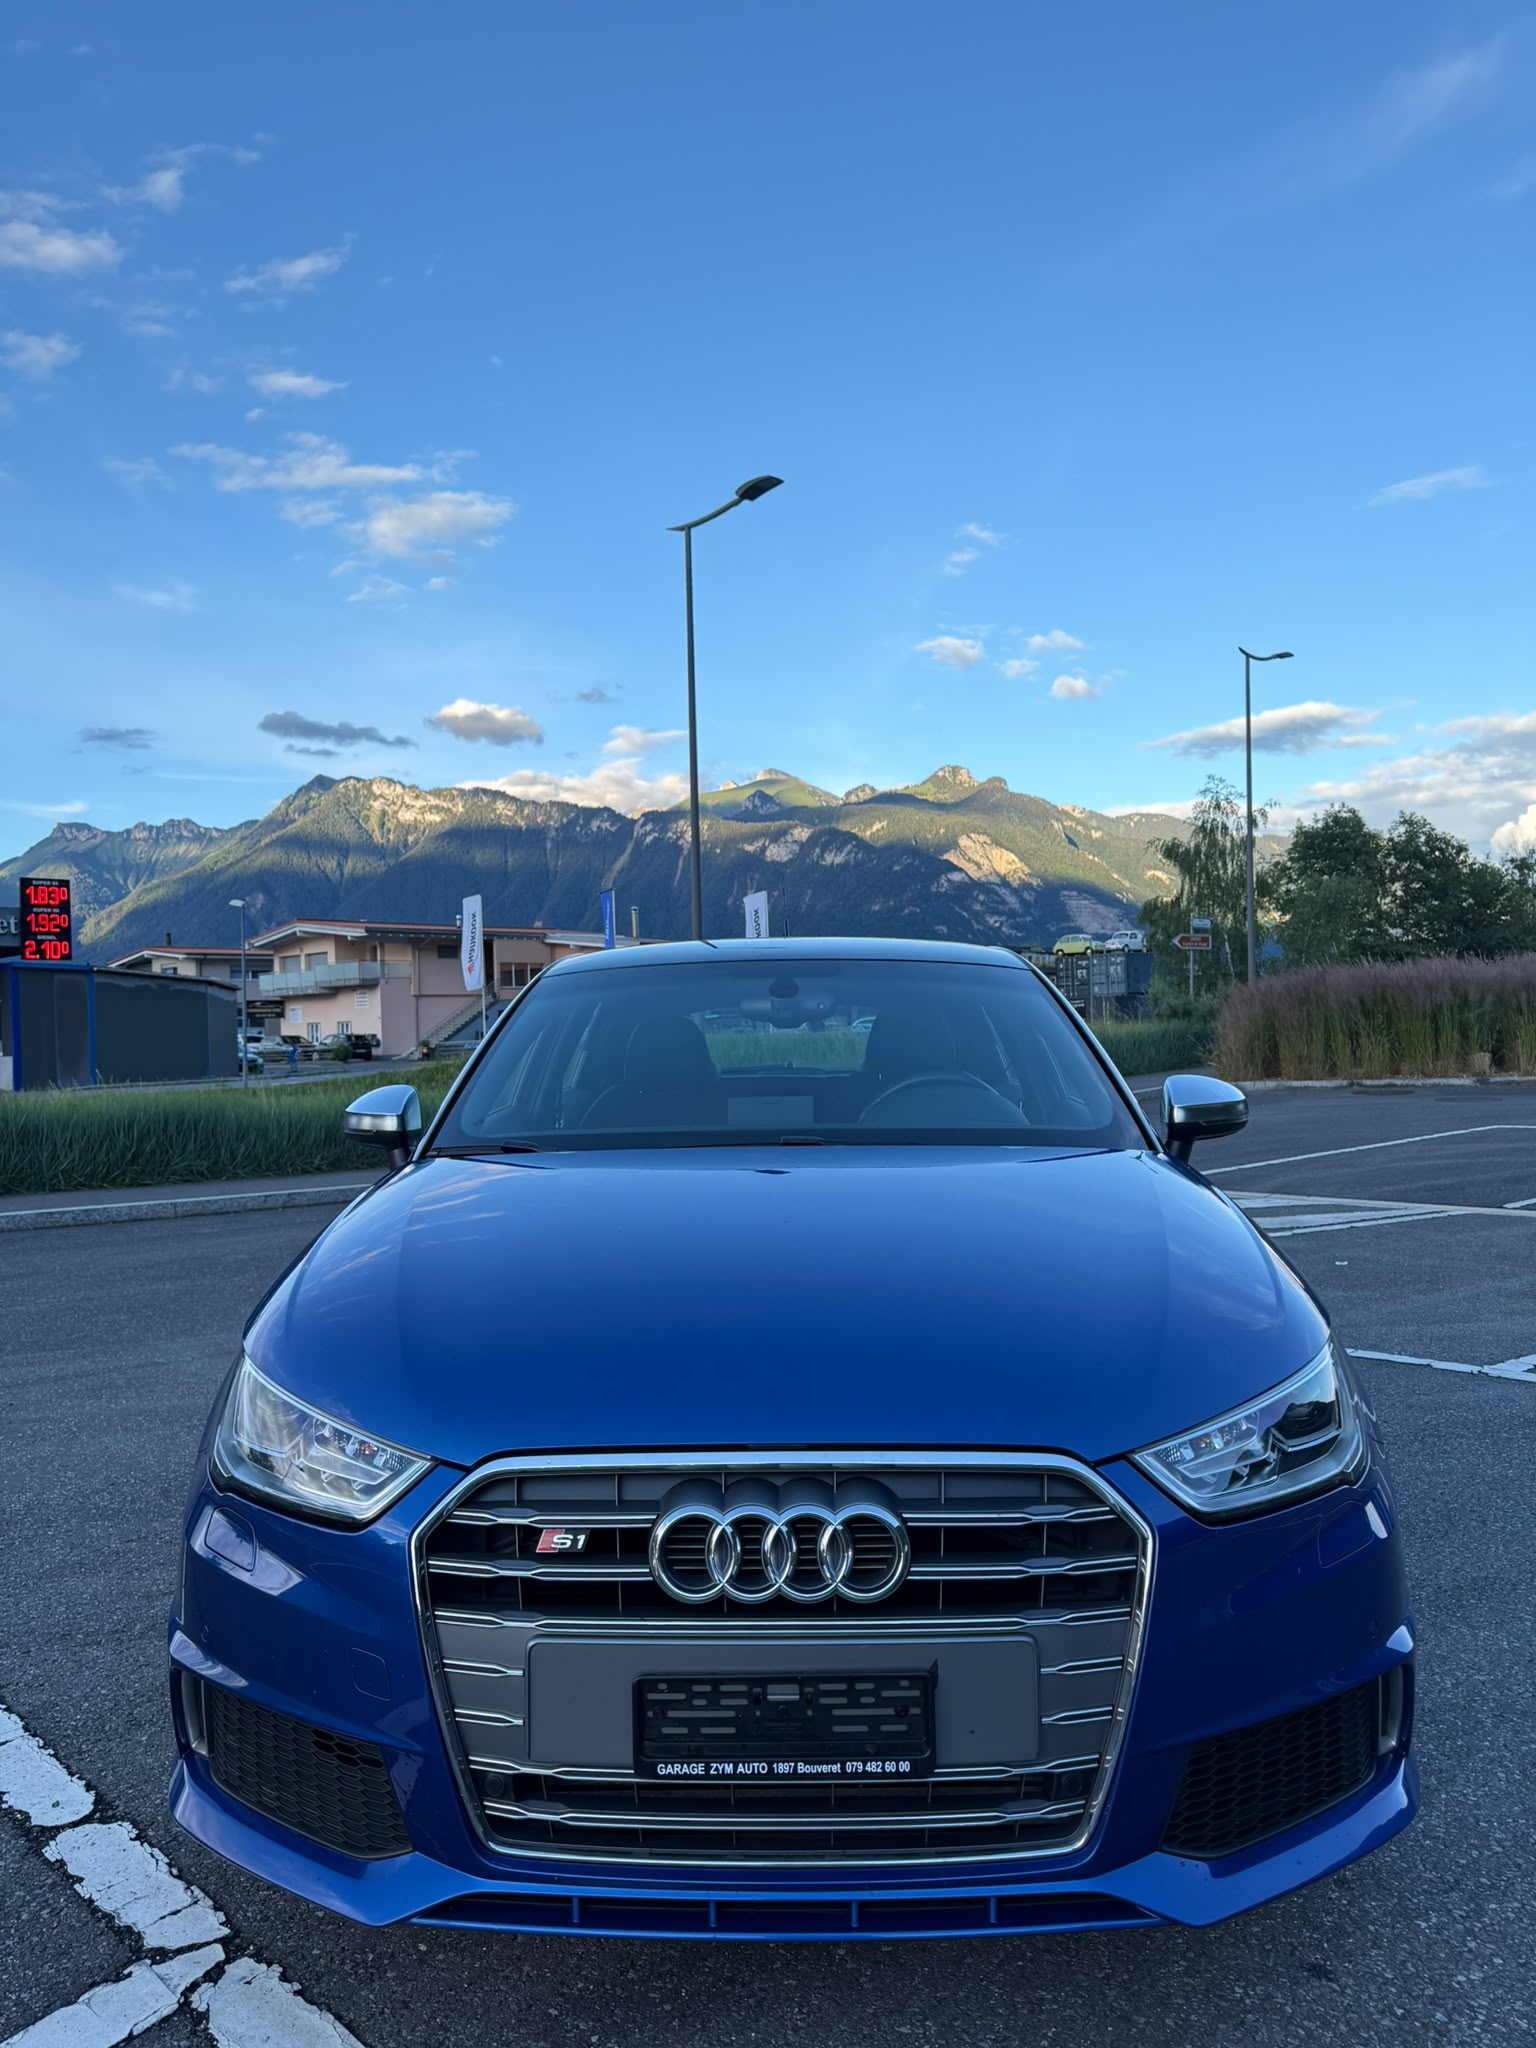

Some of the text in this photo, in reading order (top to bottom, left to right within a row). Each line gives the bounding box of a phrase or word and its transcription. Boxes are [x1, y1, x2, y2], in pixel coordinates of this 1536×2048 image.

[550, 1534, 586, 1549] S1
[657, 1761, 911, 1775] GARAGE ZYM AUTO 1897 Bouveret 079 482 60 00
